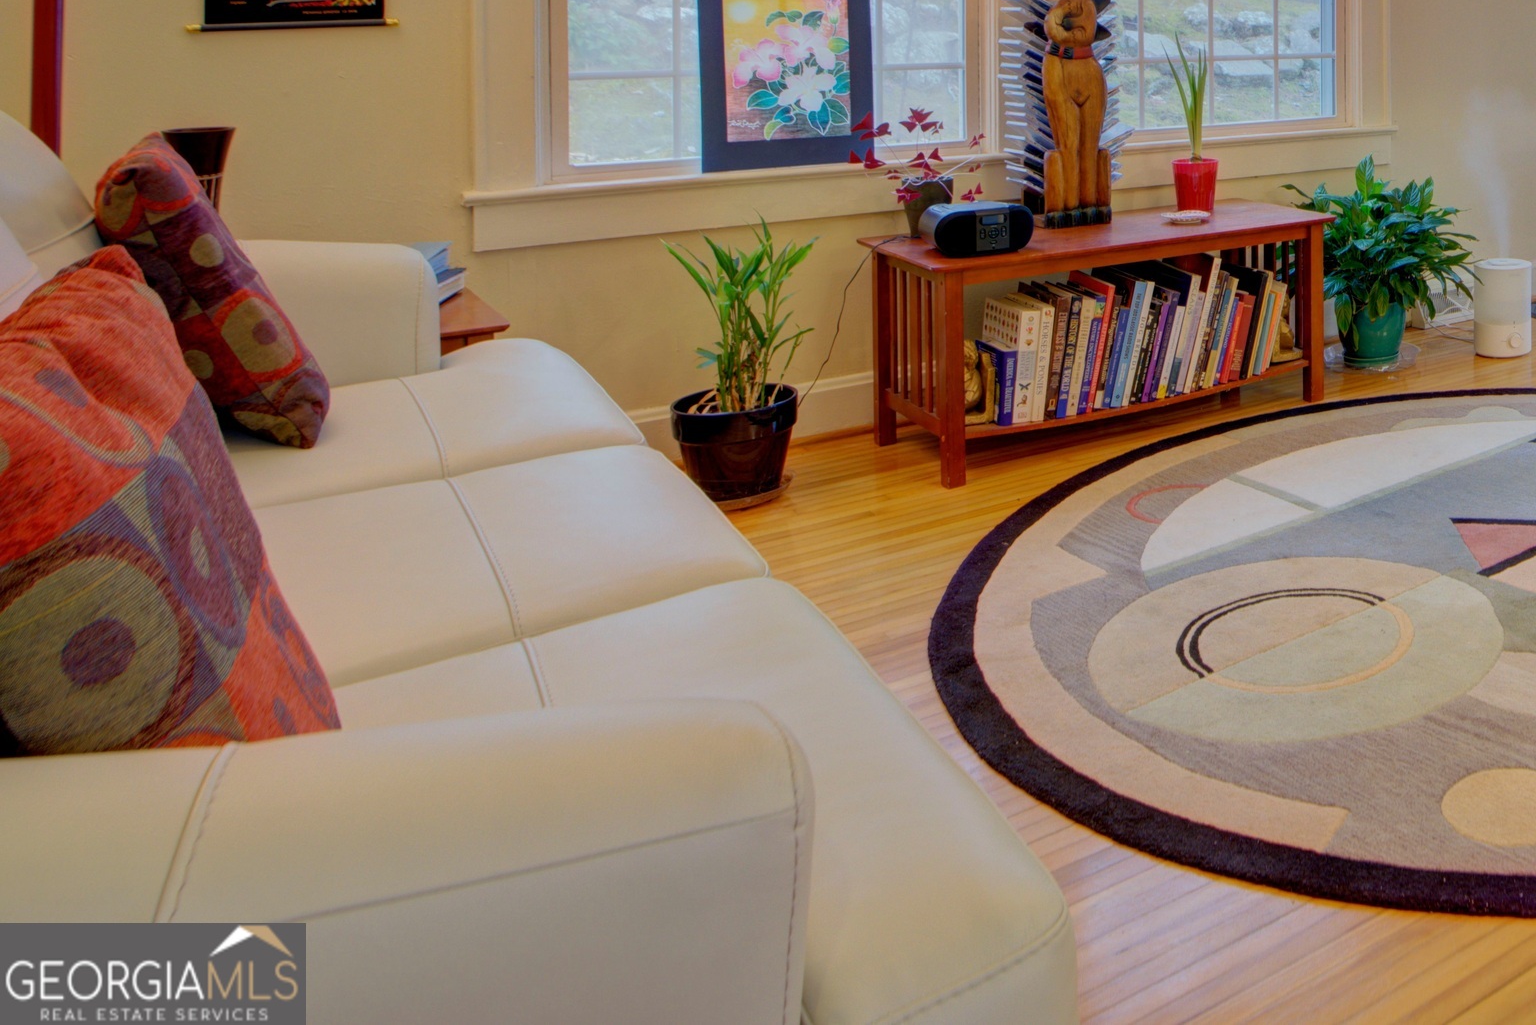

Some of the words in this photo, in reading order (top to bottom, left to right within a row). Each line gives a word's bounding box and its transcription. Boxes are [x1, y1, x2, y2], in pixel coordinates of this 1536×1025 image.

[1187, 281, 1198, 315] OCEANS
[1068, 319, 1078, 344] HISTORY
[1129, 317, 1137, 332] CLASSIC
[1138, 317, 1146, 335] DOG
[1223, 322, 1232, 349] SCOTLAND
[1040, 322, 1050, 353] HORSES
[1066, 346, 1074, 354] OF
[1123, 345, 1132, 359] SHOWS
[1131, 338, 1142, 371] BREEDS
[1006, 358, 1015, 379] AMERICA
[1065, 356, 1073, 368] THE
[1084, 343, 1095, 382] ENCYCLOPEDIA
[1036, 365, 1045, 395] PONIES
[1062, 369, 1071, 391] WORLD
